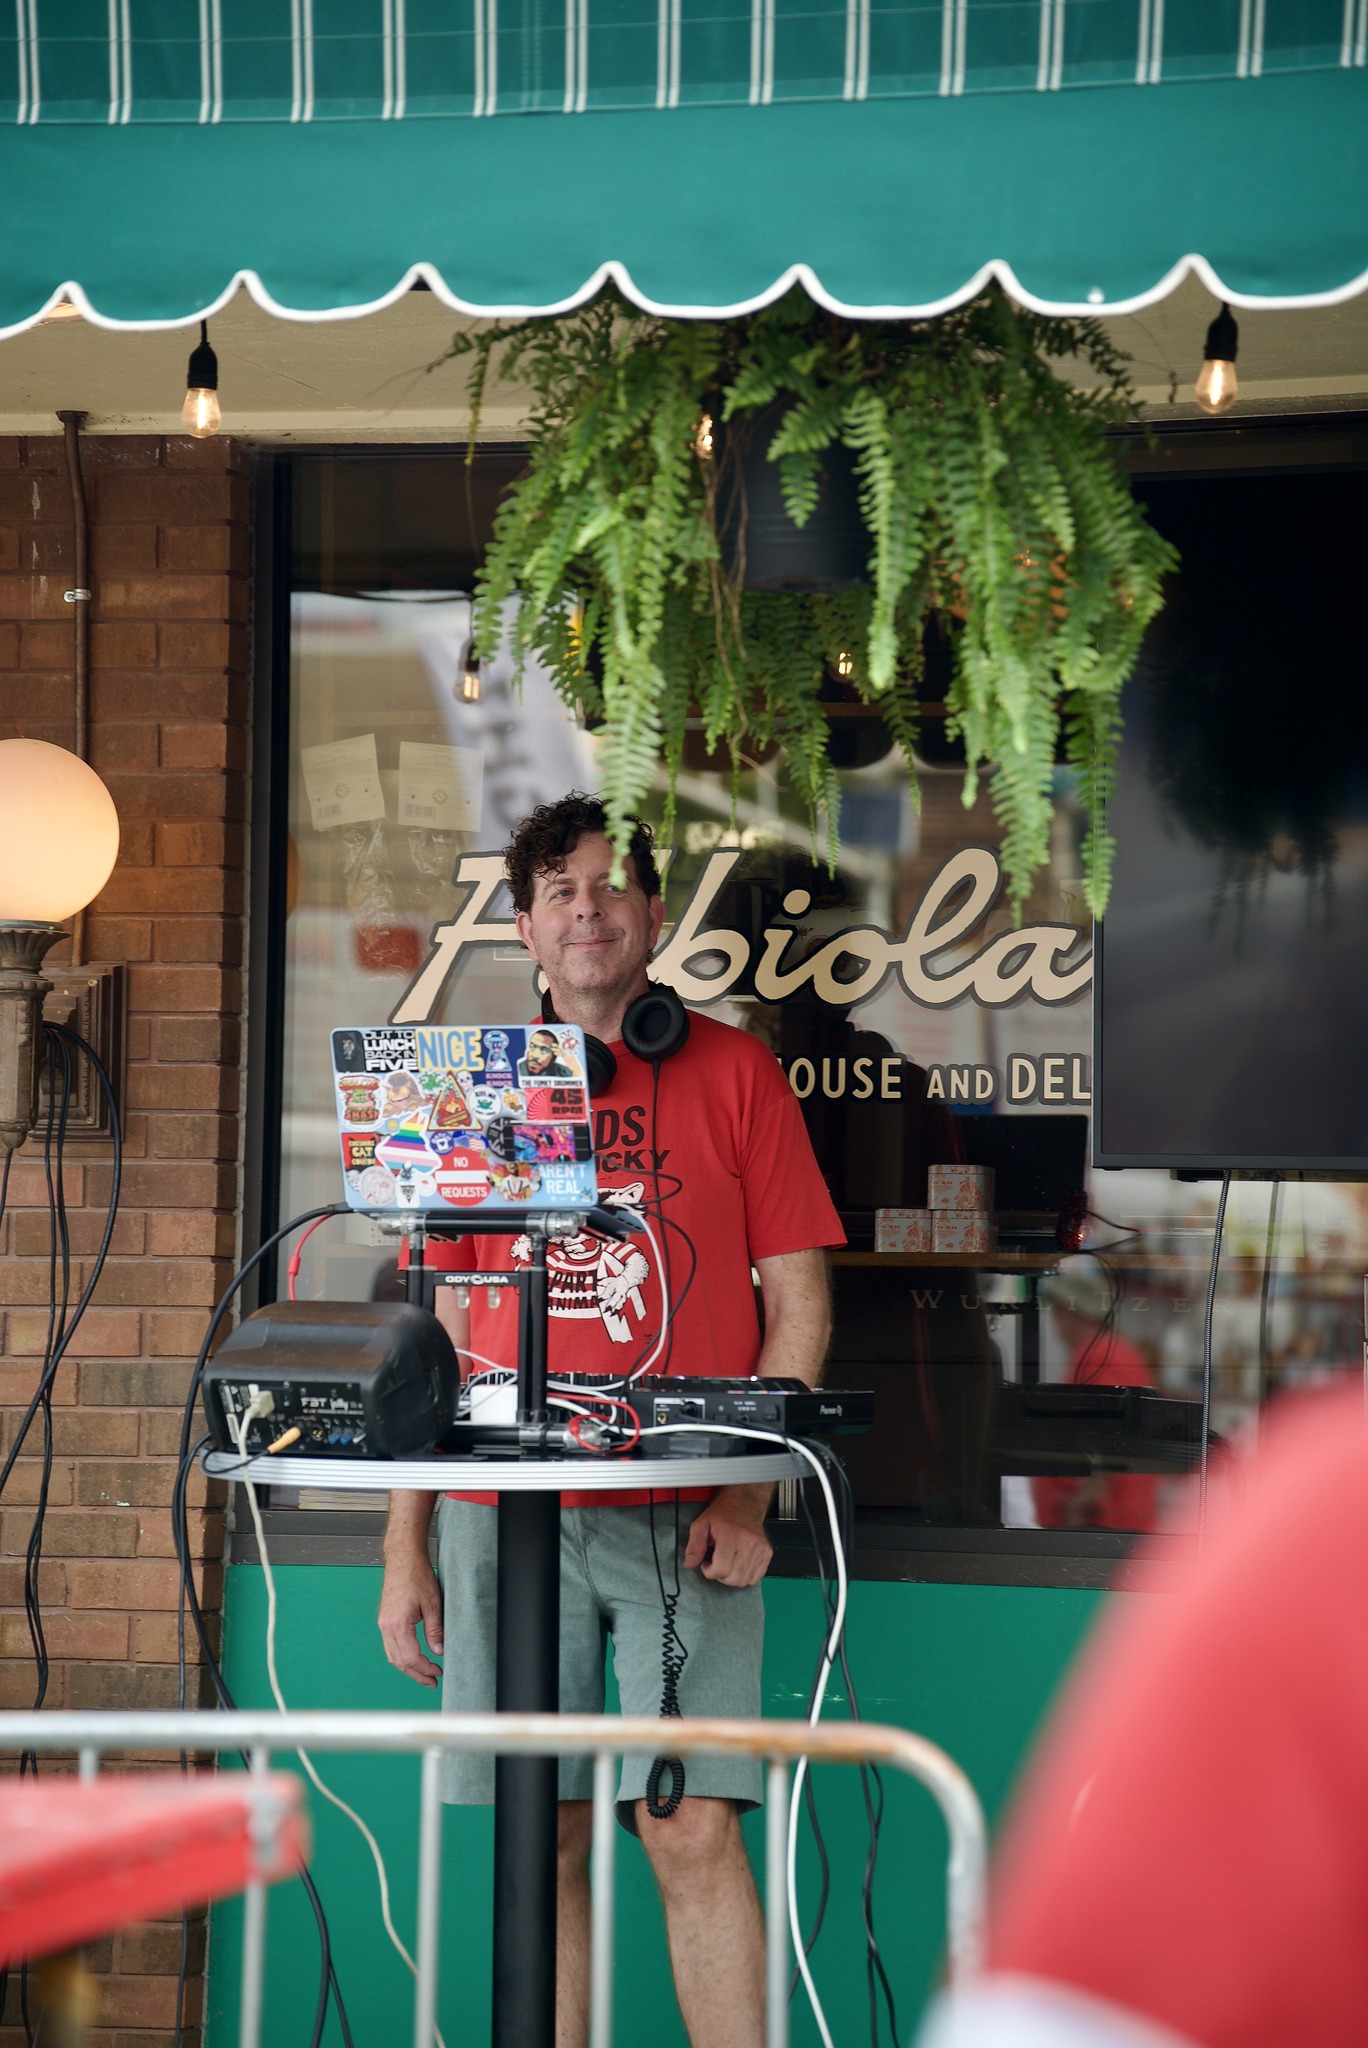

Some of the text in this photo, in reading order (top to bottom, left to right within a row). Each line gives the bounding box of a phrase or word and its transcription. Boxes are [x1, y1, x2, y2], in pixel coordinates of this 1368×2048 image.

[391, 847, 1092, 1023] Fbiola
[364, 1030, 415, 1040] OUT TO
[363, 1039, 416, 1051] LUNCH
[418, 1031, 480, 1068] NICE
[365, 1050, 417, 1060] BACK IN
[366, 1059, 418, 1071] FIVE
[777, 1057, 902, 1099] OUSE
[926, 1069, 994, 1099] AND
[550, 1089, 583, 1105] 45
[552, 1106, 583, 1114] RPM
[594, 1105, 646, 1151] DS
[352, 1147, 373, 1157] CAT
[453, 1156, 469, 1168] NO
[441, 1186, 488, 1198] REQUESTS
[546, 1180, 581, 1194] REAL
